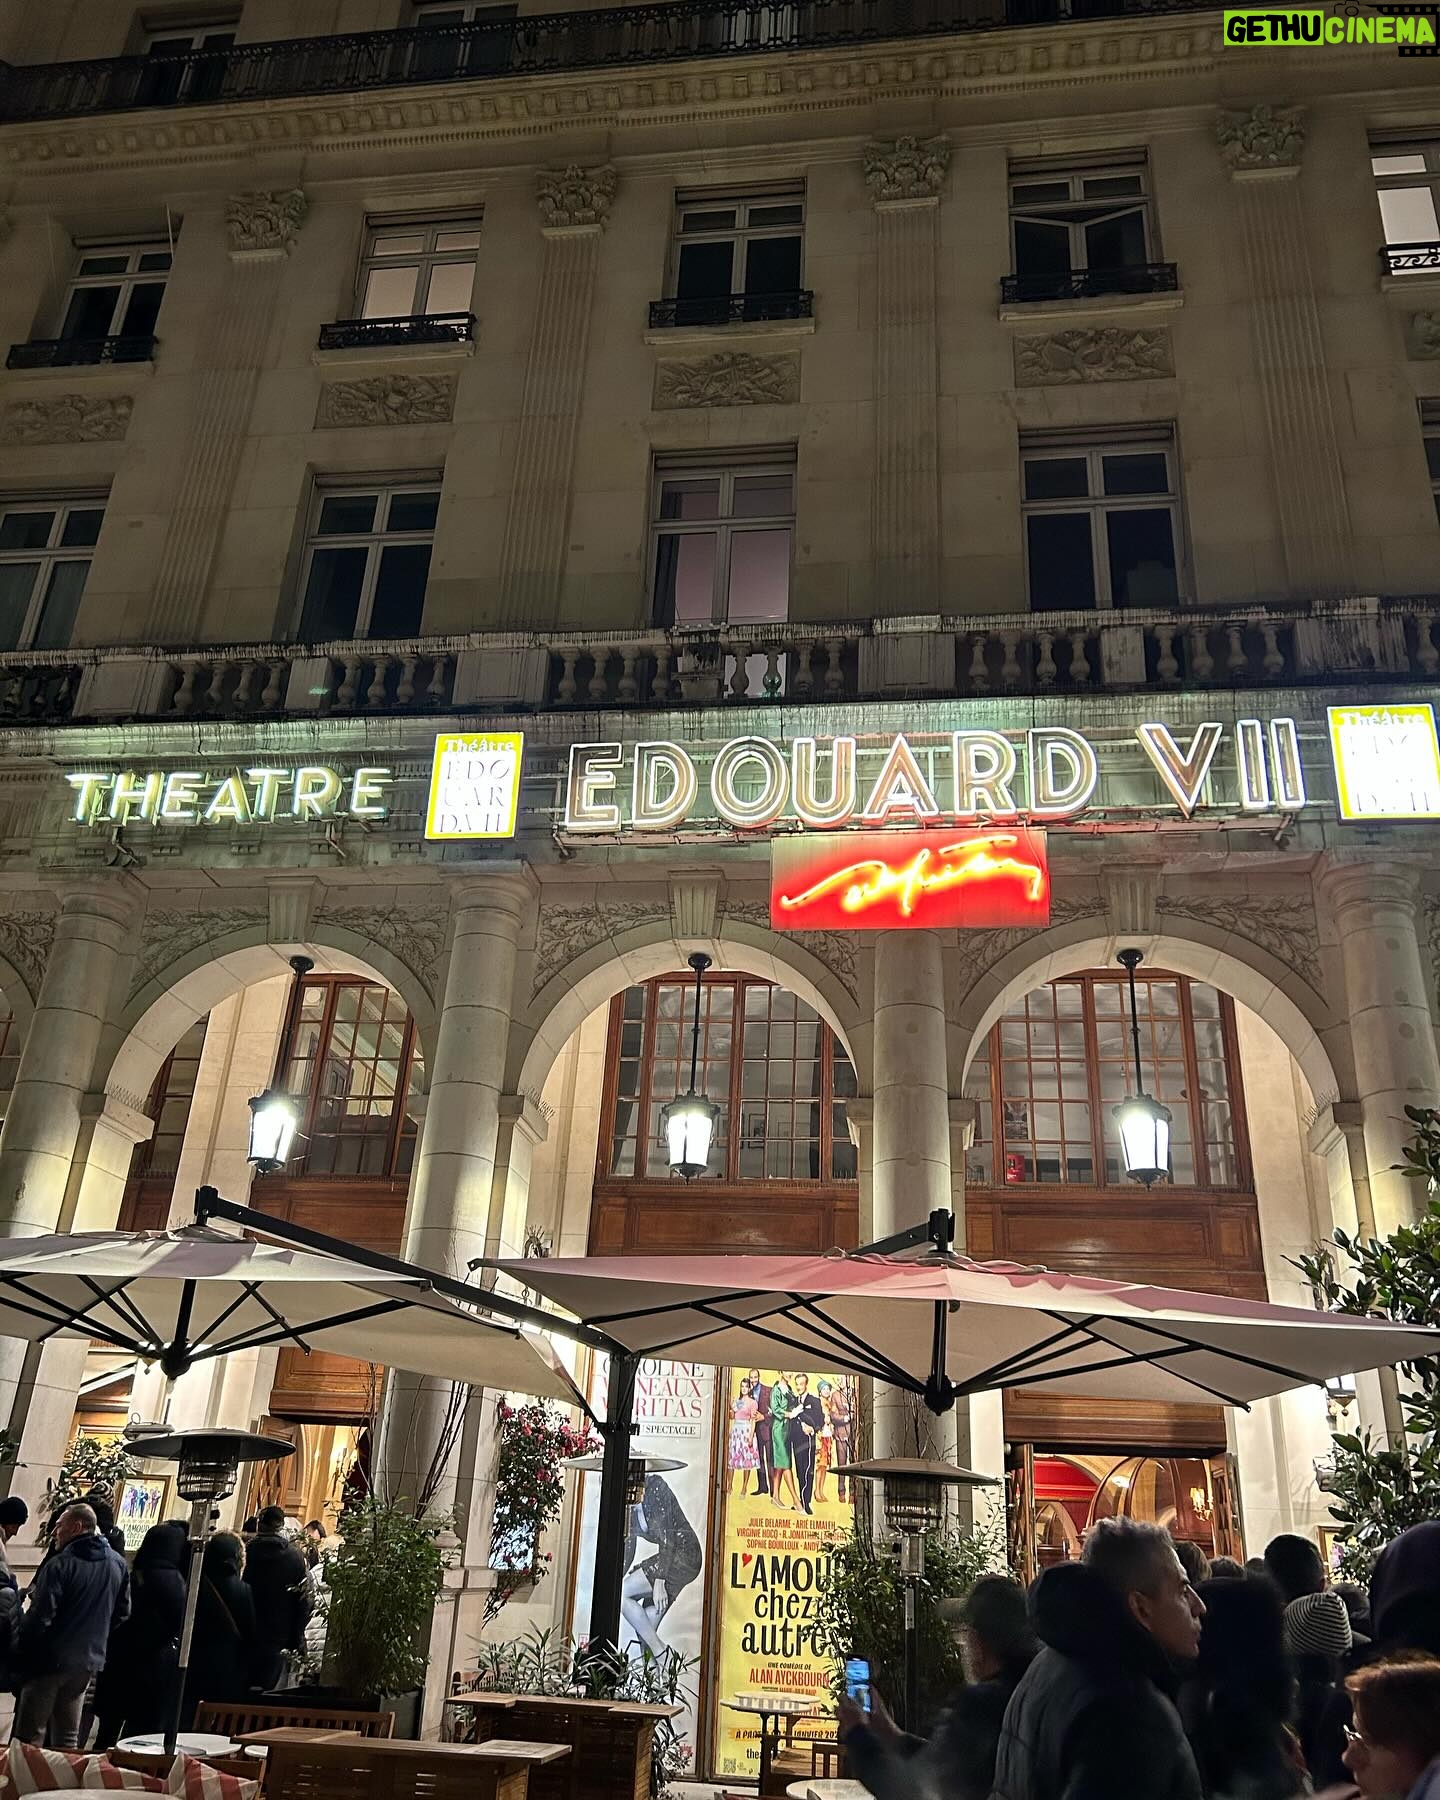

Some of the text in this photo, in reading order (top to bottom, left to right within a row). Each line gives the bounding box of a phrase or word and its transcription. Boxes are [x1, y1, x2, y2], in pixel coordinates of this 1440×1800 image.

[563, 717, 1305, 832] EDOUARD VII
[65, 765, 394, 827] THEATRE
[645, 1425, 696, 1435] SPECTACLE
[737, 1528, 761, 1538] VIRGINIE
[762, 1530, 778, 1540] HOCQ
[748, 1518, 764, 1527] JULIE
[765, 1519, 791, 1528] DELARME
[795, 1519, 809, 1530] ARIÉ
[746, 1539, 767, 1549] SOPHIE
[768, 1541, 800, 1551] BOUILLOUX
[731, 1552, 835, 1593] L'AMOU
[754, 1587, 812, 1621] chez
[749, 1668, 829, 1688] ALAN AYCKBOURN
